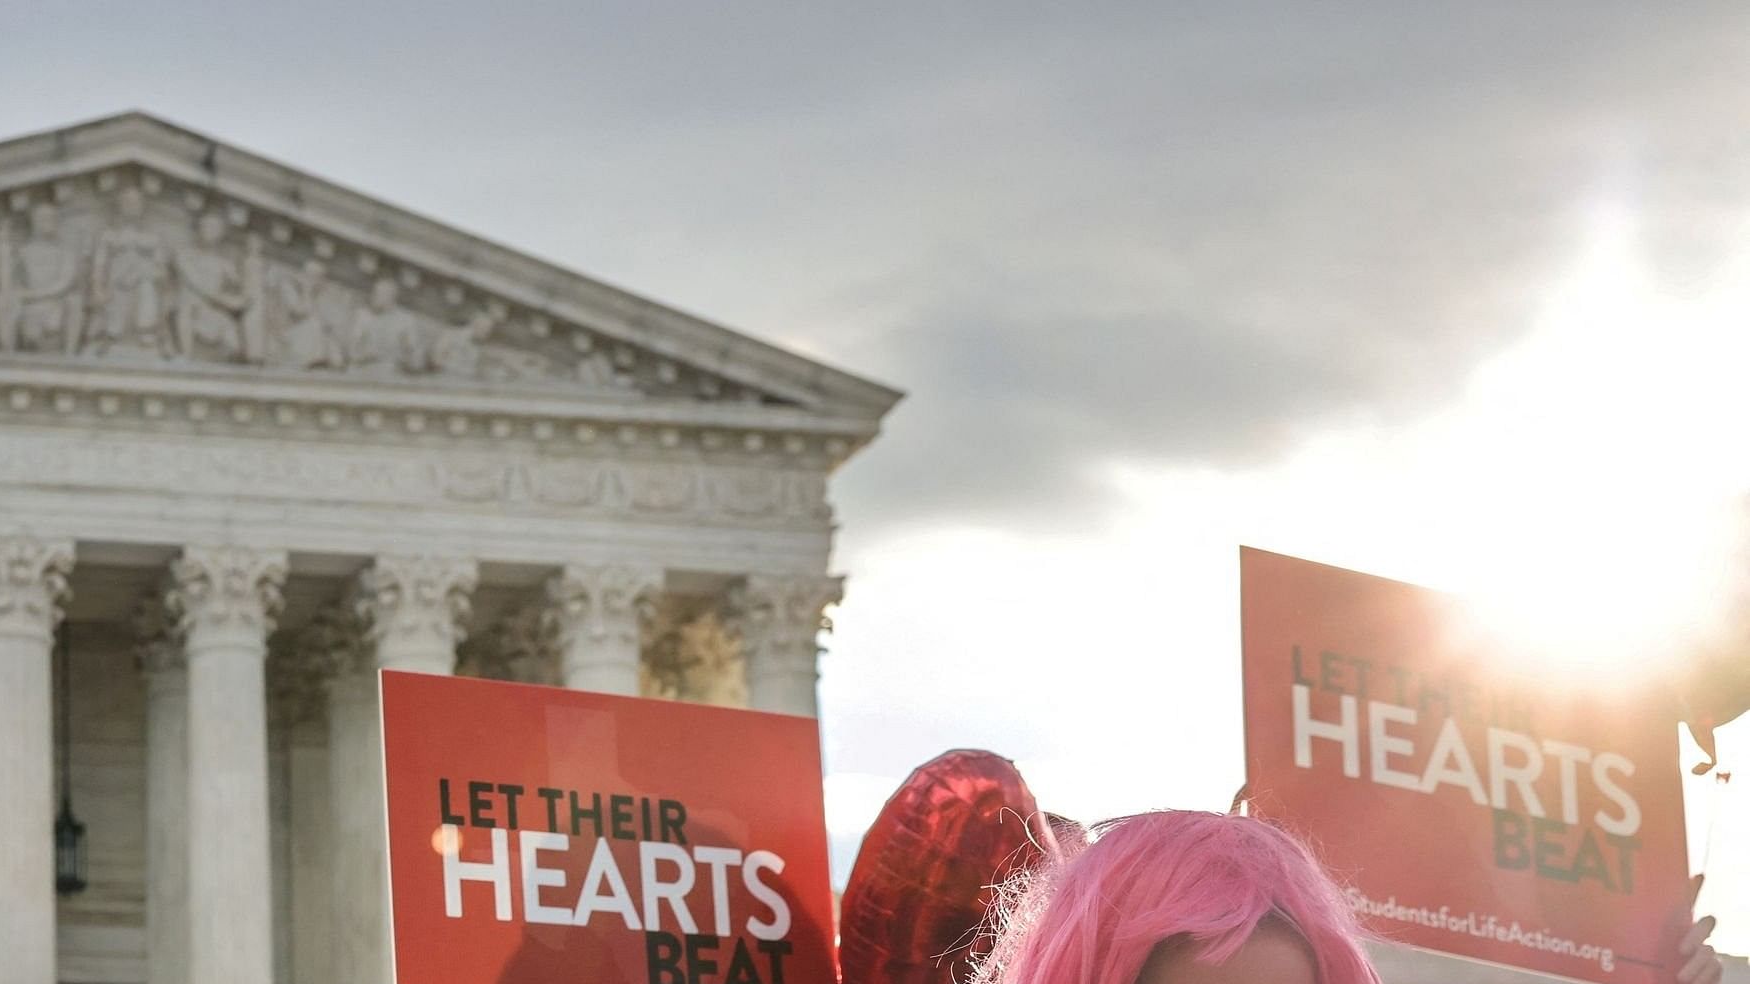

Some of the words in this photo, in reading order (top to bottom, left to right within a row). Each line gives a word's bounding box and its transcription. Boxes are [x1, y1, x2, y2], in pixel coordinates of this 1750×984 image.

[1292, 645, 1373, 698] LET
[1292, 683, 1643, 837] HEARTS
[439, 778, 524, 830] LET
[537, 786, 688, 846] THEIR
[1492, 807, 1643, 895] BEAT
[440, 823, 793, 941] HEARTS
[1344, 887, 1616, 973] StudentsforLifeAction.org
